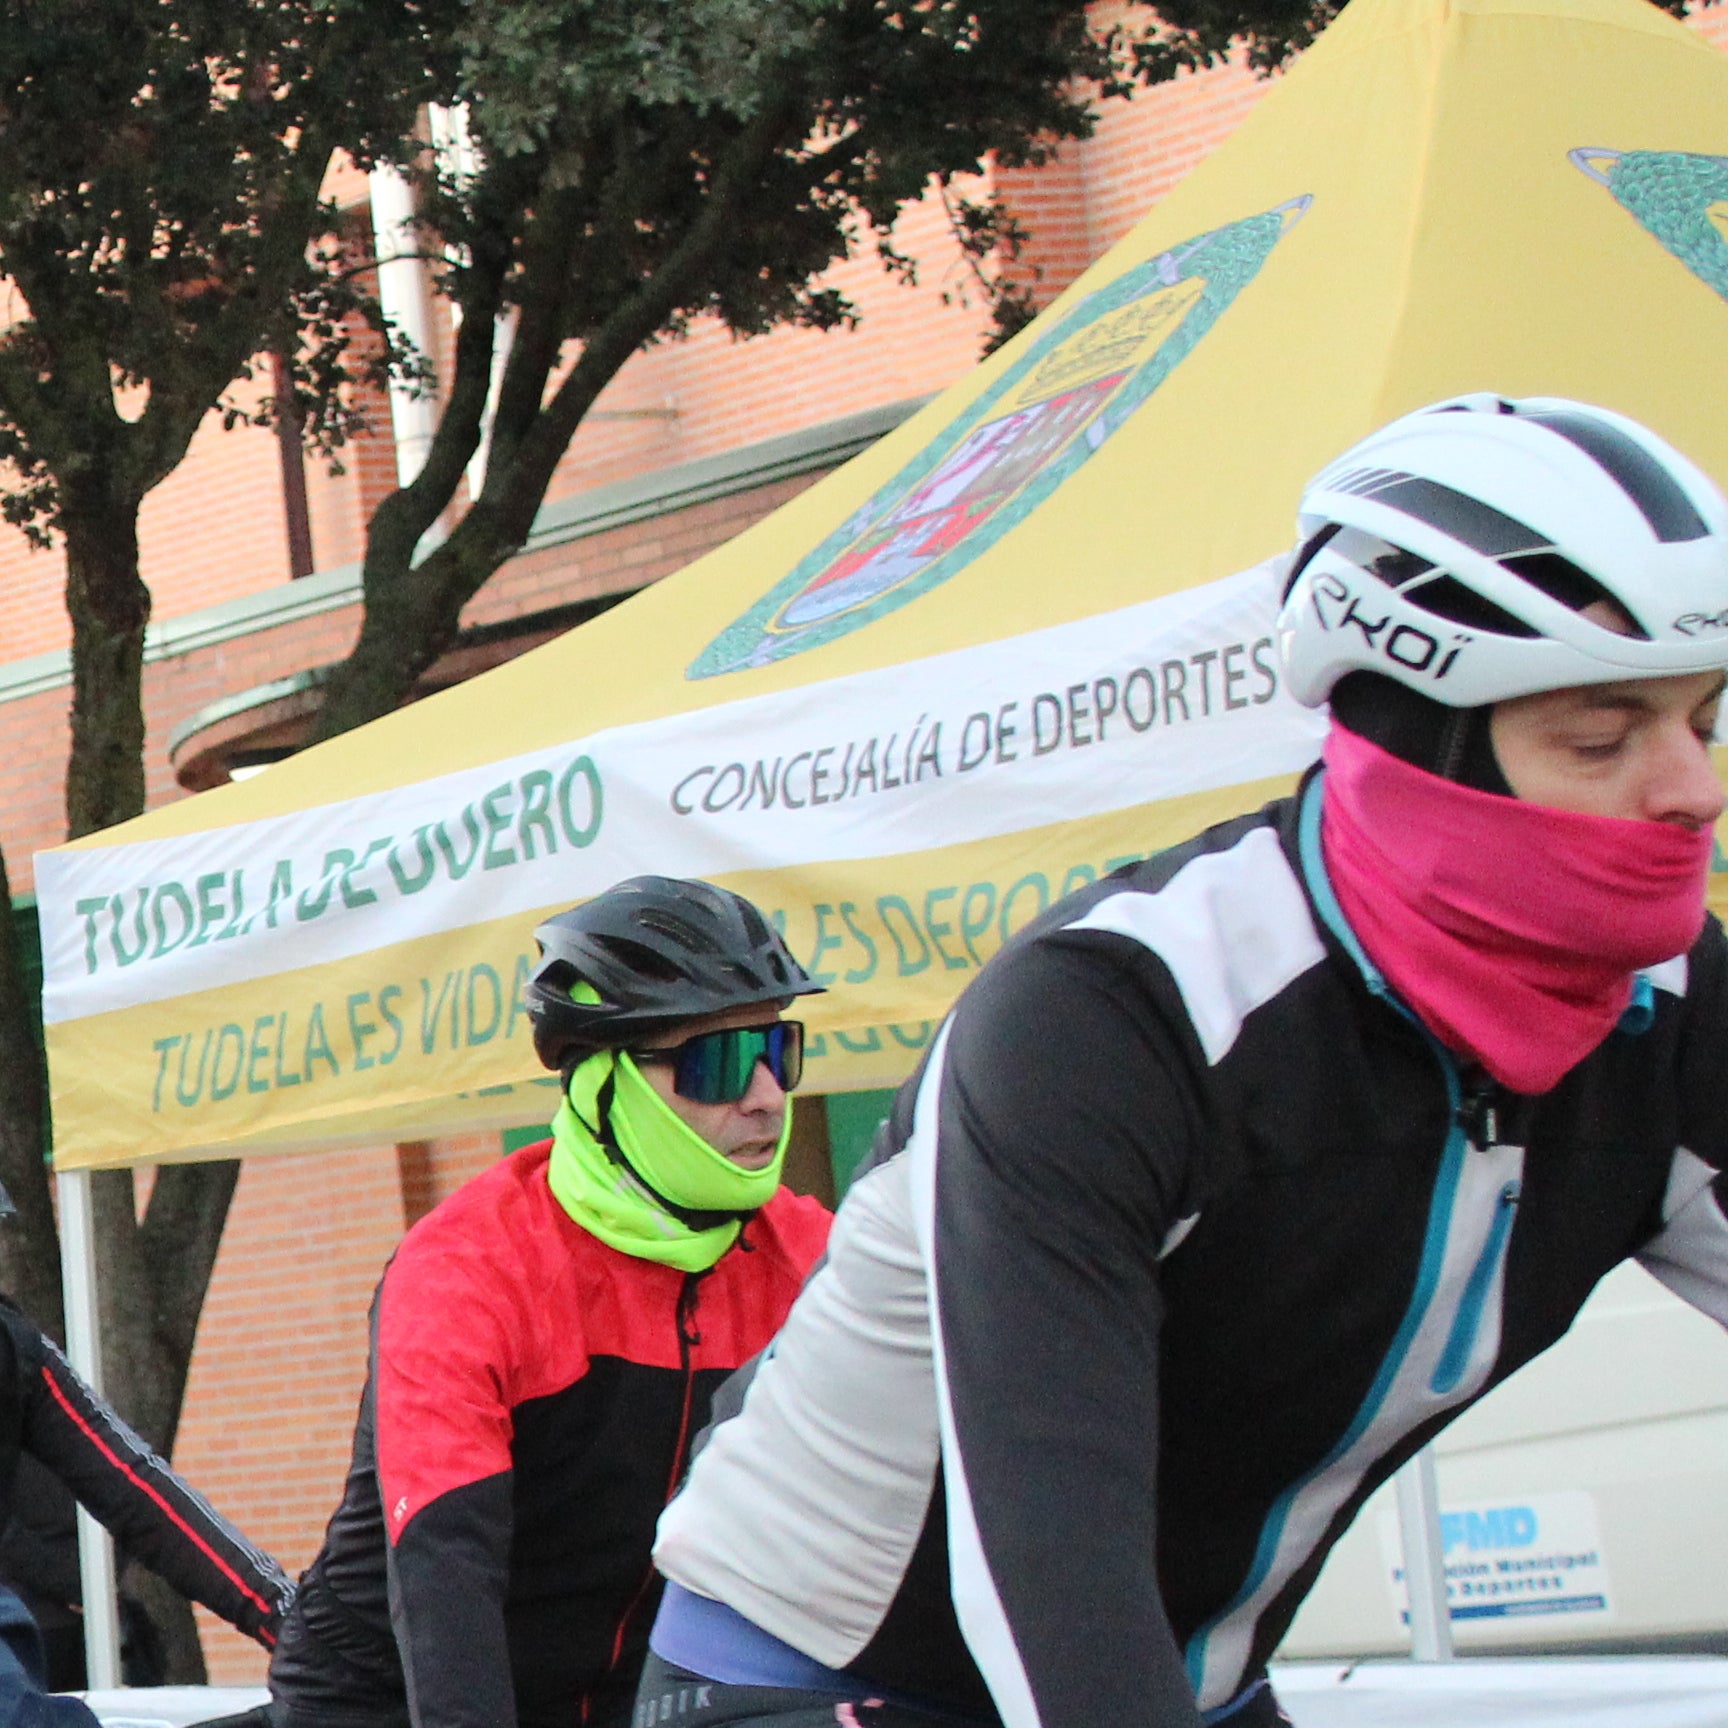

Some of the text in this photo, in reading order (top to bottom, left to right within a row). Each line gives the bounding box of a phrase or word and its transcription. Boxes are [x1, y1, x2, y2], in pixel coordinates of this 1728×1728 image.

[670, 712, 944, 817] CONCEJALÍA
[956, 700, 1019, 774] DE
[1031, 636, 1279, 758] DEPORTES
[151, 1003, 340, 1113] TUDELA
[352, 984, 404, 1074] ES
